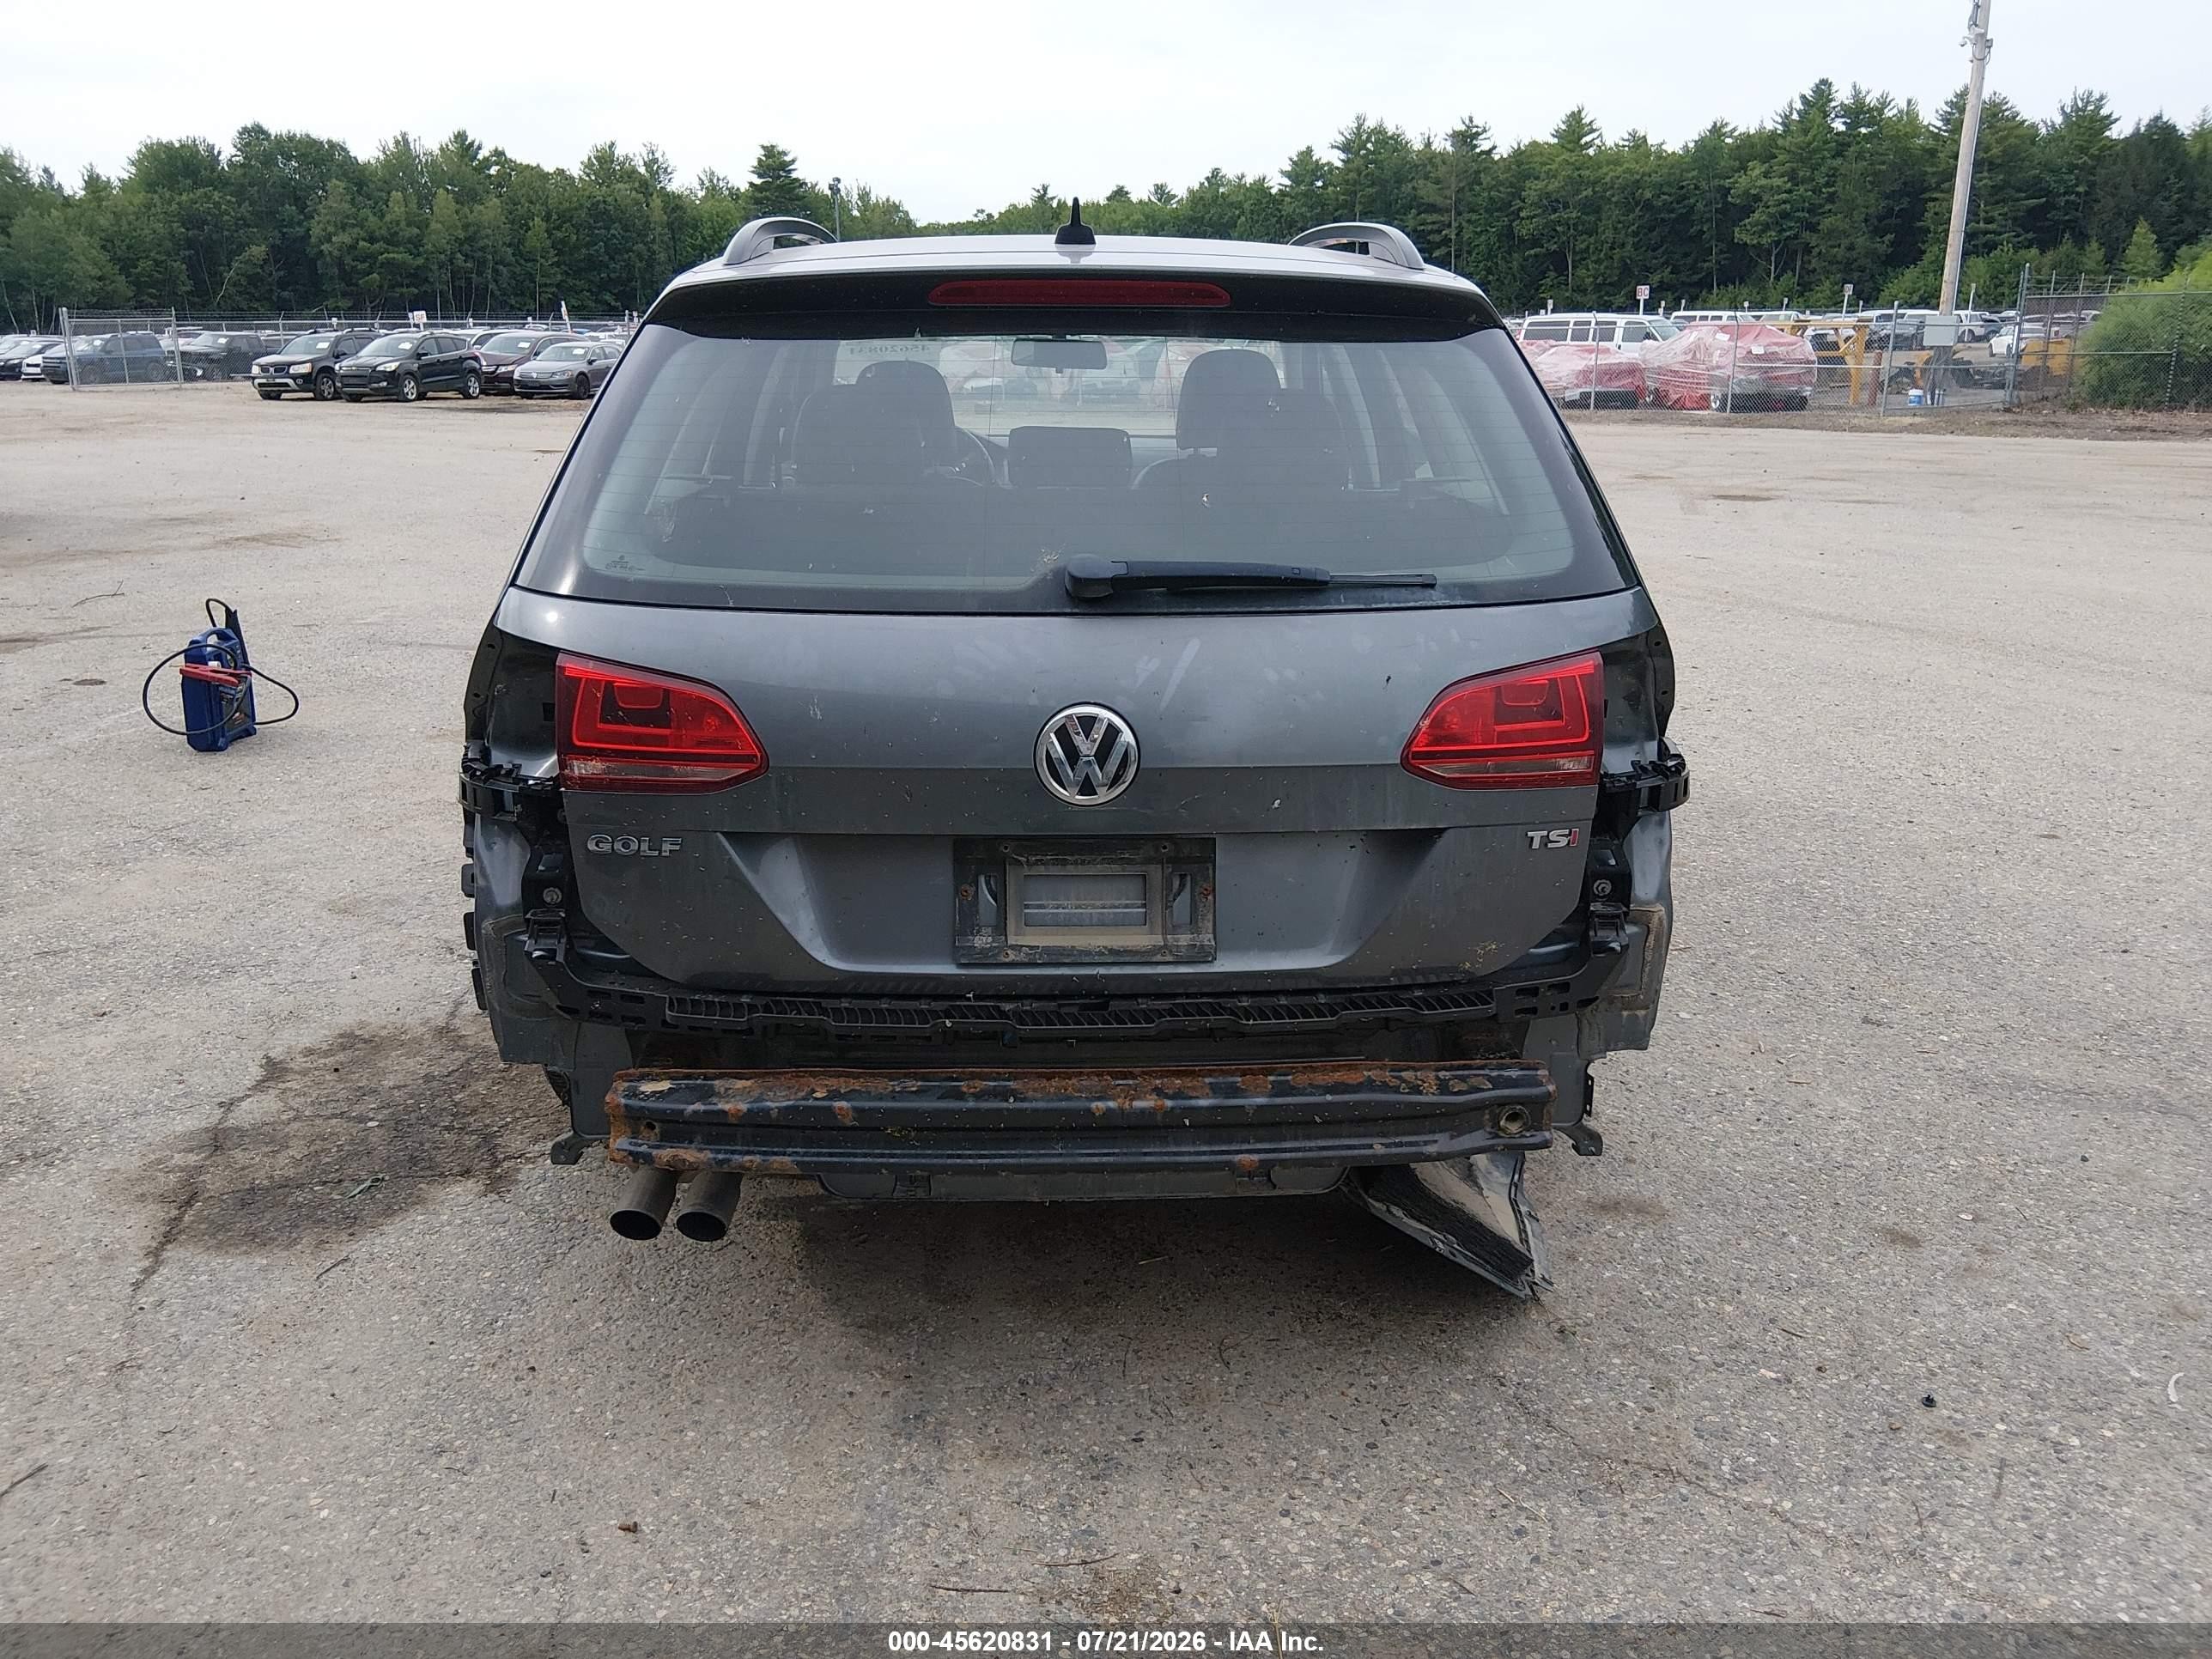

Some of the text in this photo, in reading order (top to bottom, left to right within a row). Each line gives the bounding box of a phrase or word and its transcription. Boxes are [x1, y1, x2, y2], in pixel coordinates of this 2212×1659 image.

[1638, 287, 1649, 297] BC
[1043, 710, 1132, 801] VW
[587, 834, 682, 856] GOLF
